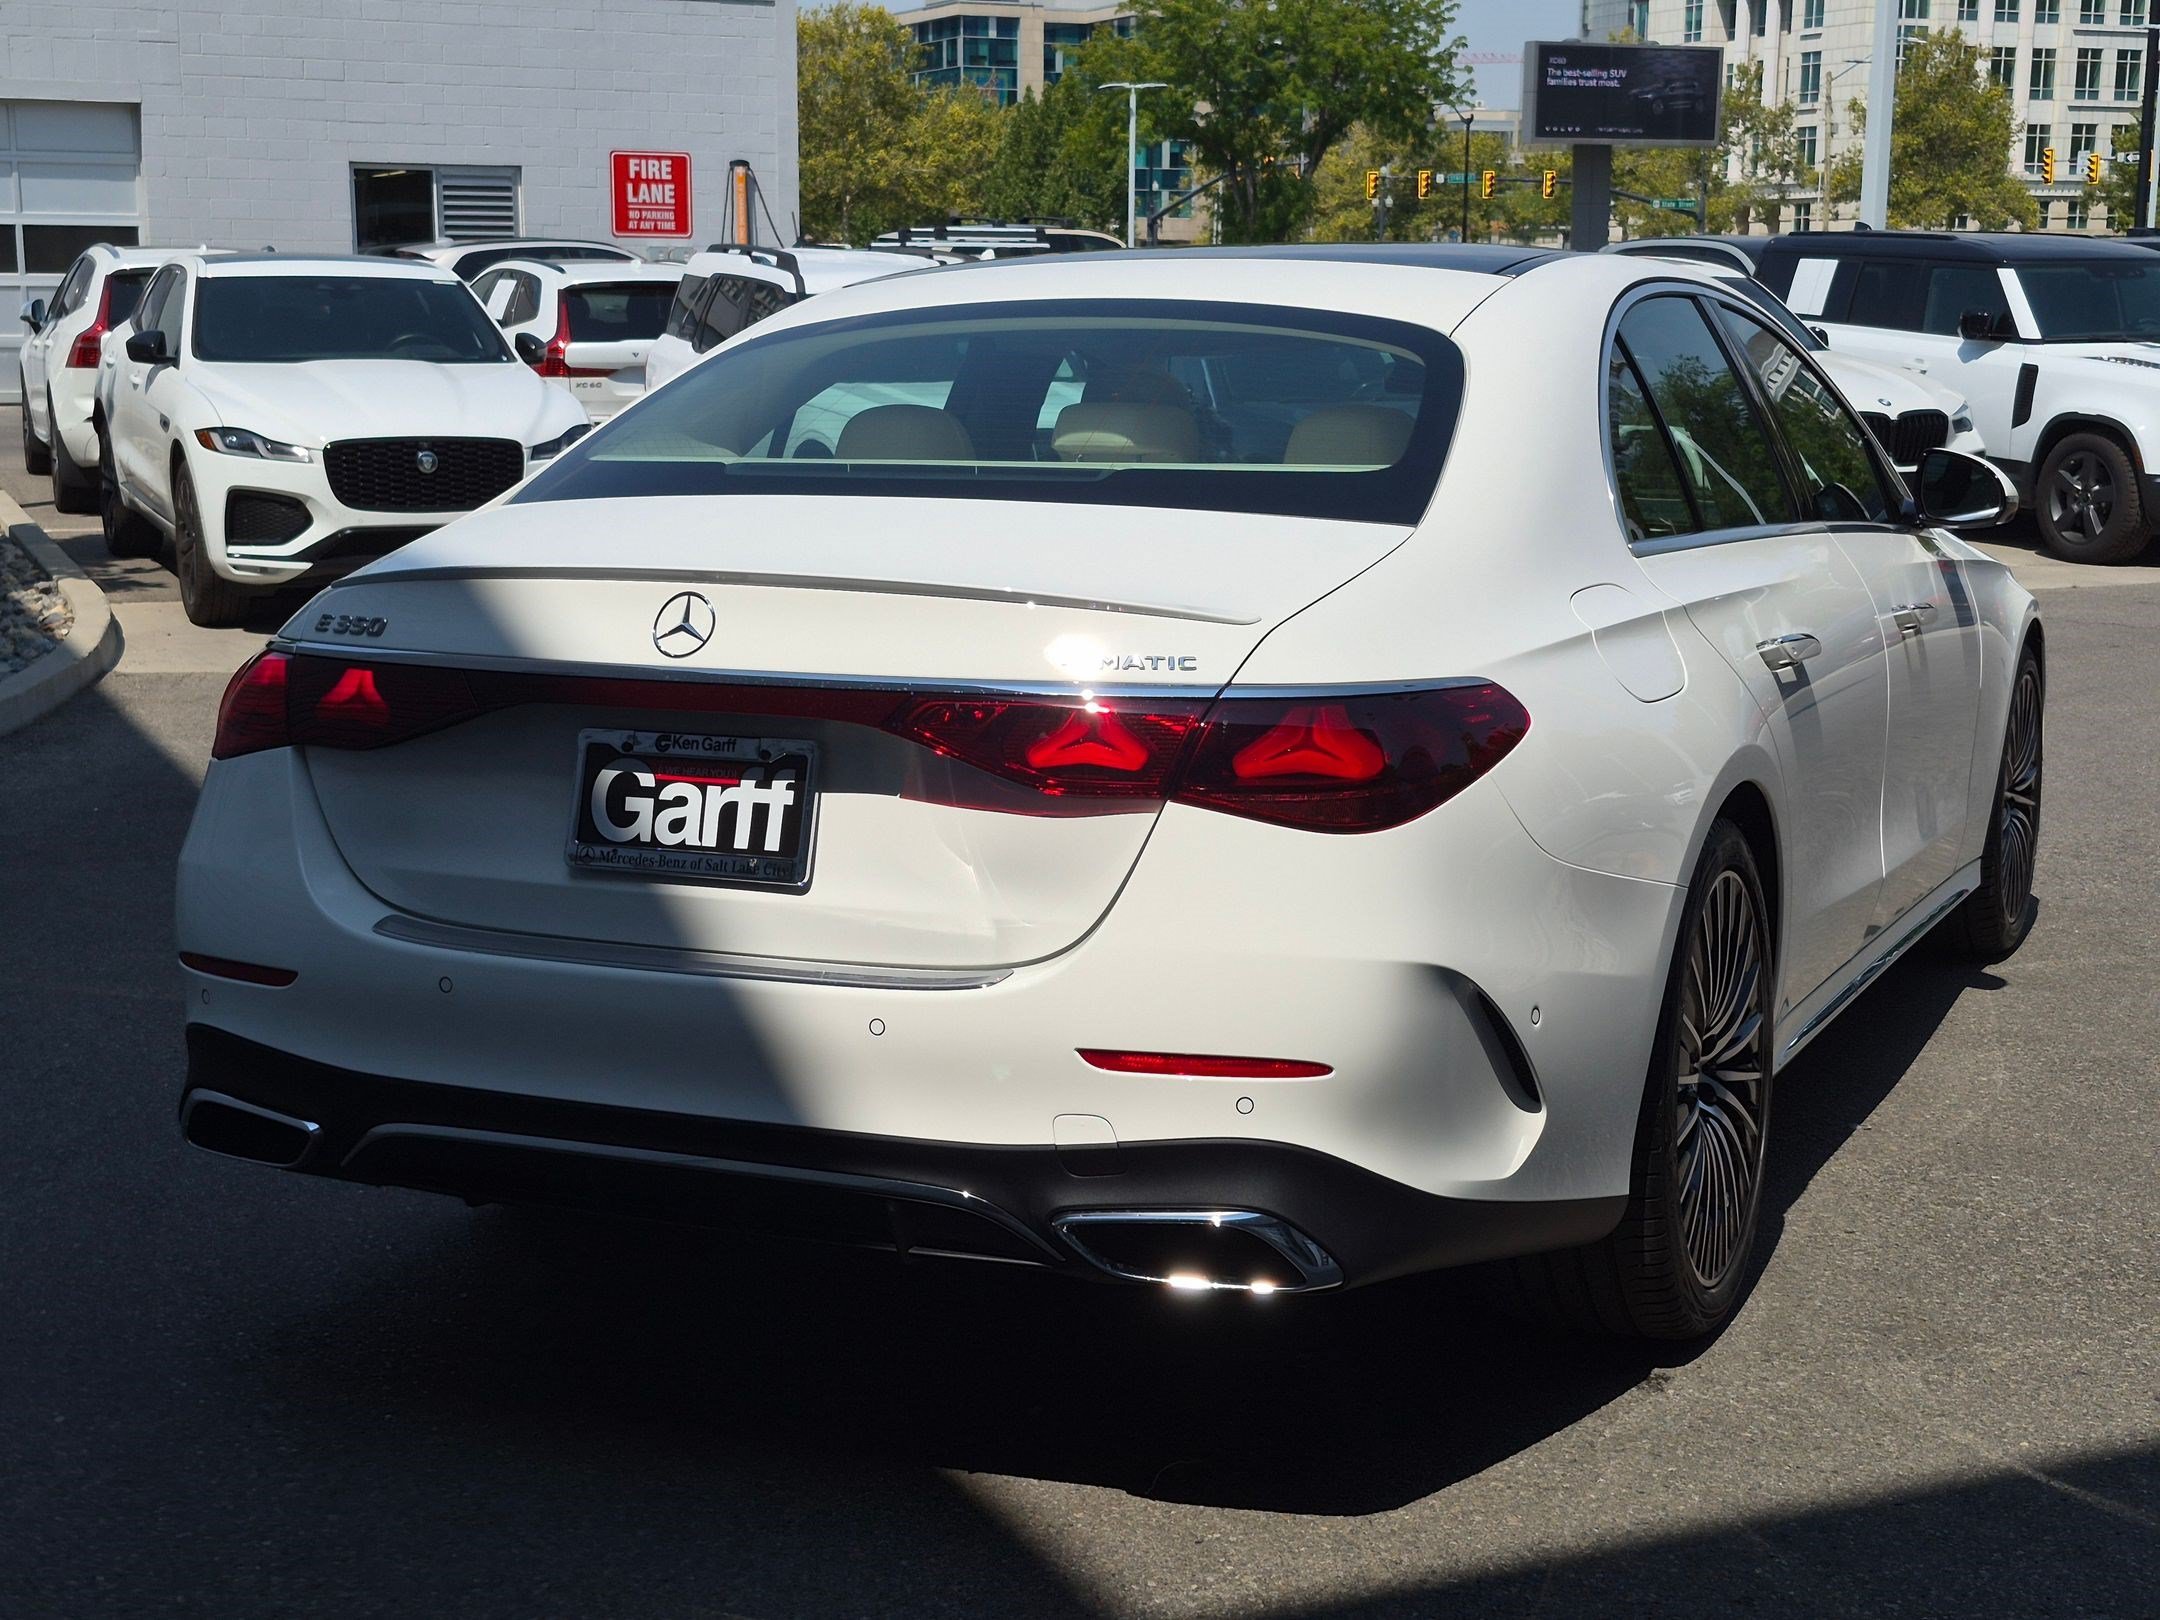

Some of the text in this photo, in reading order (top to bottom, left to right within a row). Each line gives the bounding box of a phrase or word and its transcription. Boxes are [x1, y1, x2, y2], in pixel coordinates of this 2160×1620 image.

[1547, 68, 1627, 79] The best-selling SUV
[1547, 78, 1577, 86] families
[1578, 78, 1598, 87] trust
[629, 158, 672, 180] FIRE
[627, 183, 675, 204] LANE
[628, 210, 675, 220] NO PARKING
[628, 221, 676, 231] AT ANY TIME
[1072, 655, 1198, 671] MATIC
[672, 735, 737, 753] Ken Garff
[591, 757, 796, 852] Garff
[600, 849, 791, 879] Mercedes-Benz of Salt Lake City
